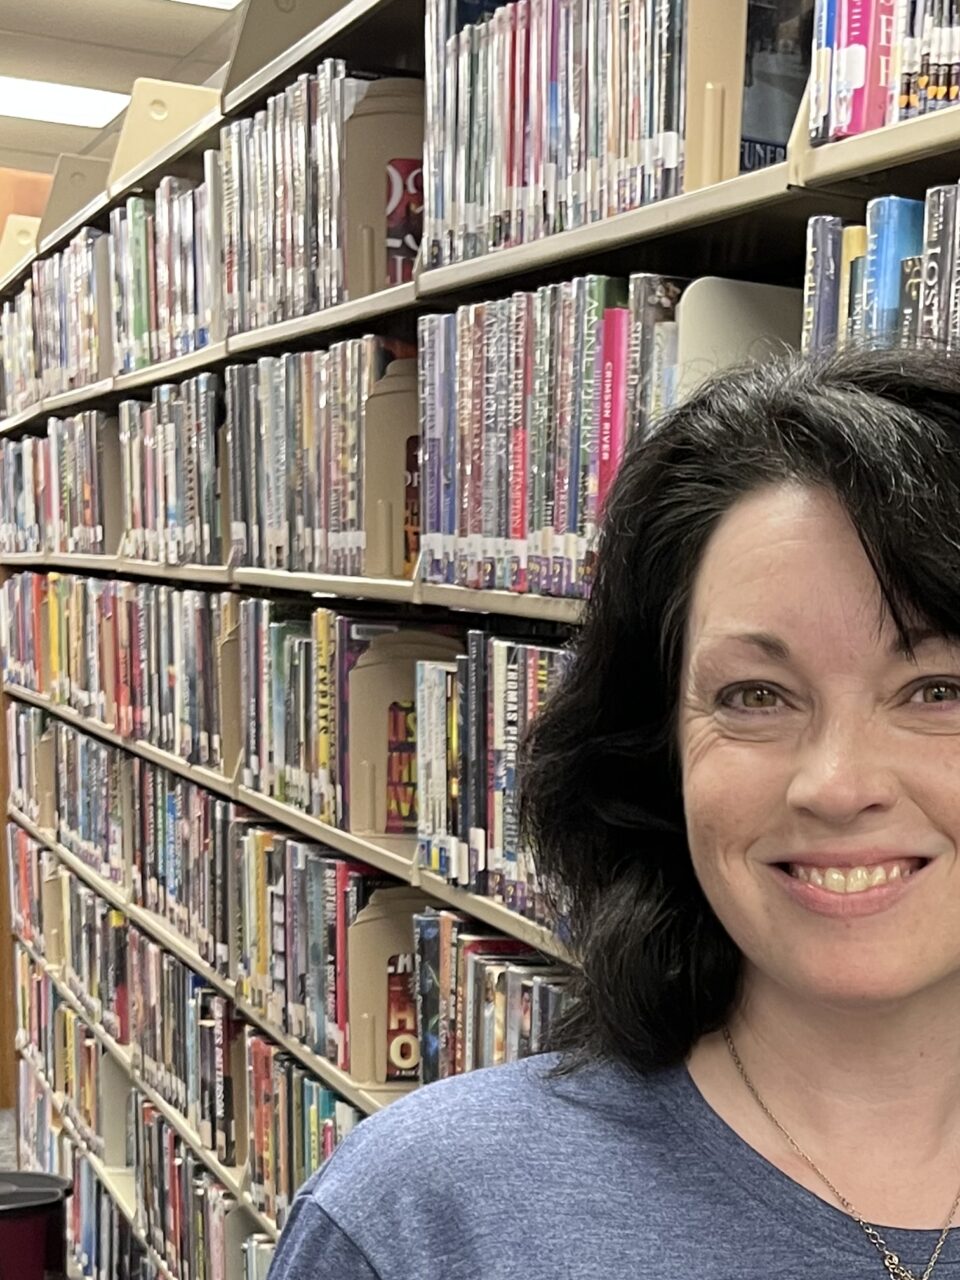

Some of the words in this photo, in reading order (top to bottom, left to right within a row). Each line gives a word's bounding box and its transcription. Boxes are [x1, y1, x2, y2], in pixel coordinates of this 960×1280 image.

[603, 361, 613, 420] CRIMSON
[602, 423, 611, 462] RIVER
[505, 664, 518, 723] THOMAS
